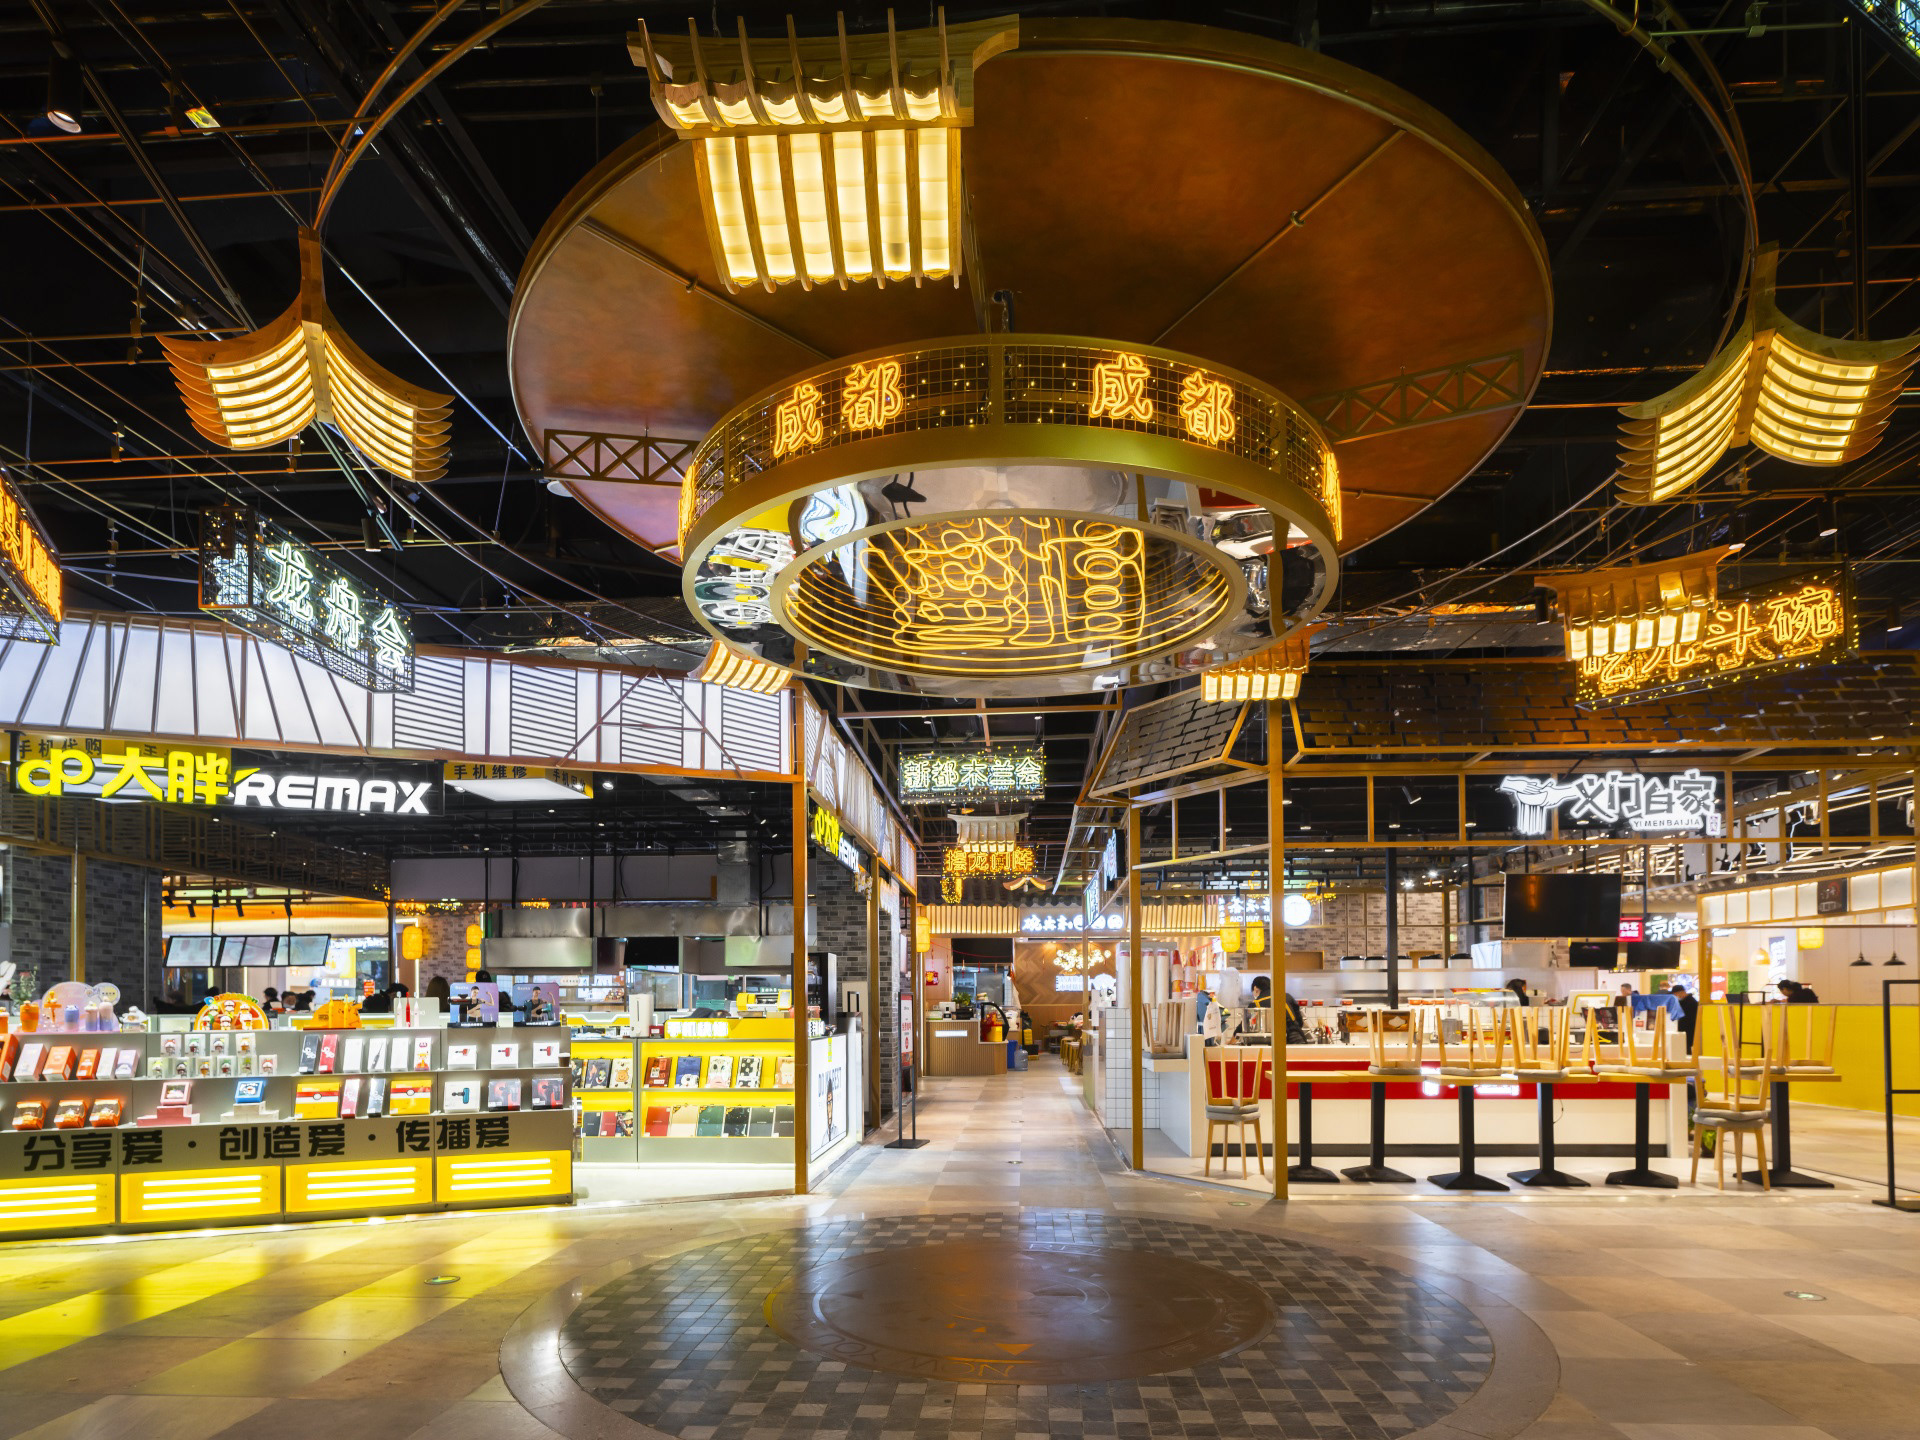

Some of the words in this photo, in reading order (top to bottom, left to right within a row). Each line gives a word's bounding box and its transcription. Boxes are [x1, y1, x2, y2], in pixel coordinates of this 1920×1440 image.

[102, 747, 229, 805] 大胖
[234, 768, 432, 814] REMAX
[454, 764, 527, 780] 手机维修
[904, 757, 1042, 787] 新都木兰会
